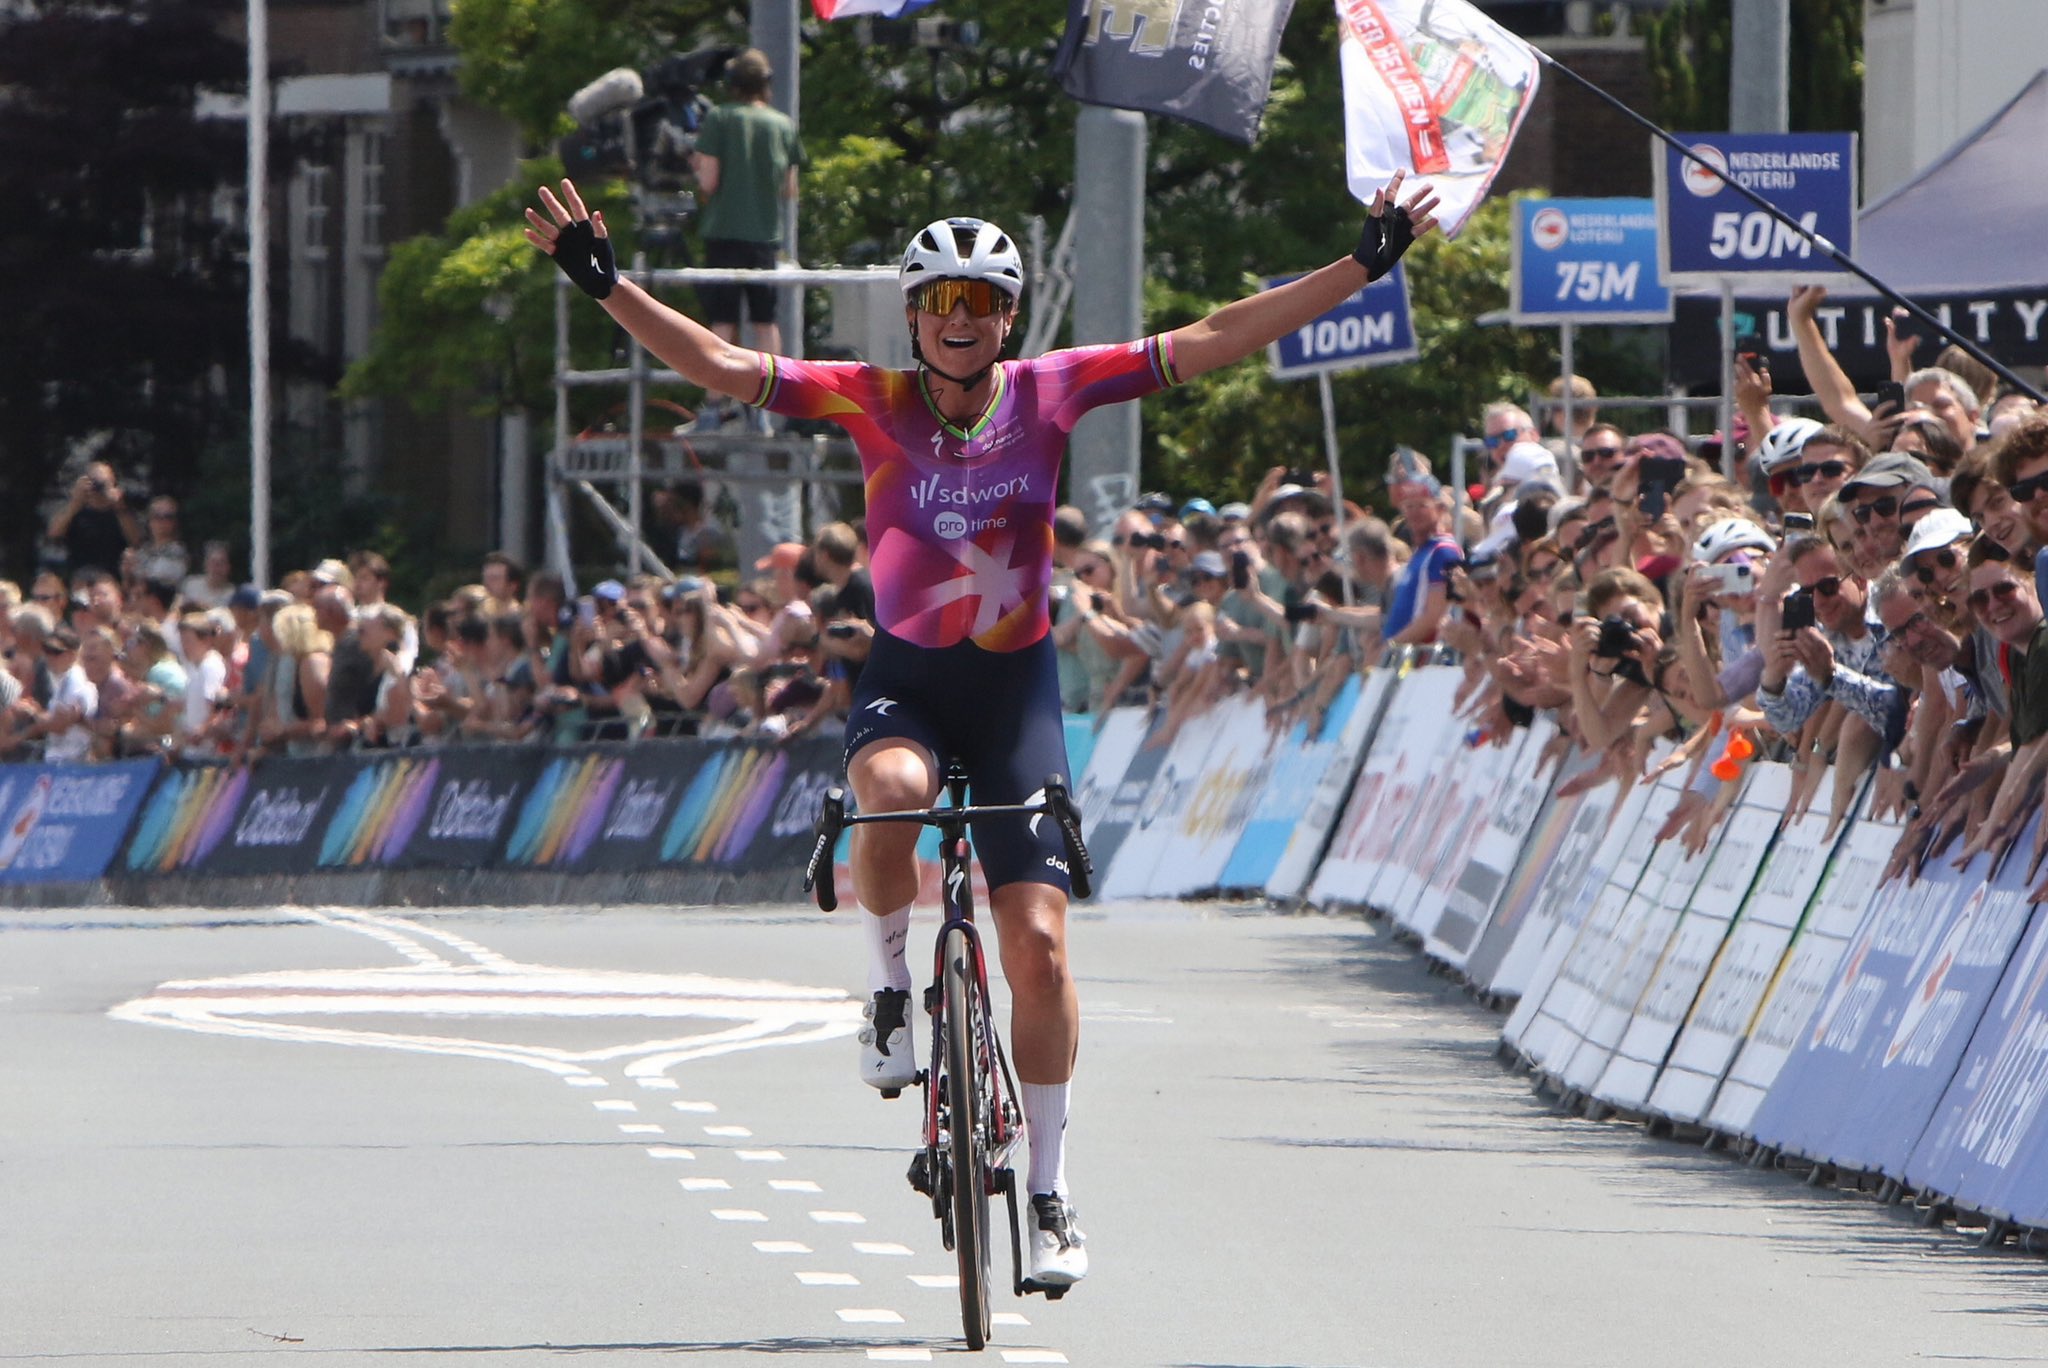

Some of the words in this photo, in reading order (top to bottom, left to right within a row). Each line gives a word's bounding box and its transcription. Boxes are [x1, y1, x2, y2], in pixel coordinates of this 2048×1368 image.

[1729, 152, 1840, 170] NEDERLANDSE
[1710, 212, 1817, 259] 50M
[1556, 261, 1640, 301] 75M
[1299, 311, 1395, 357] 100M
[939, 521, 964, 535] pro
